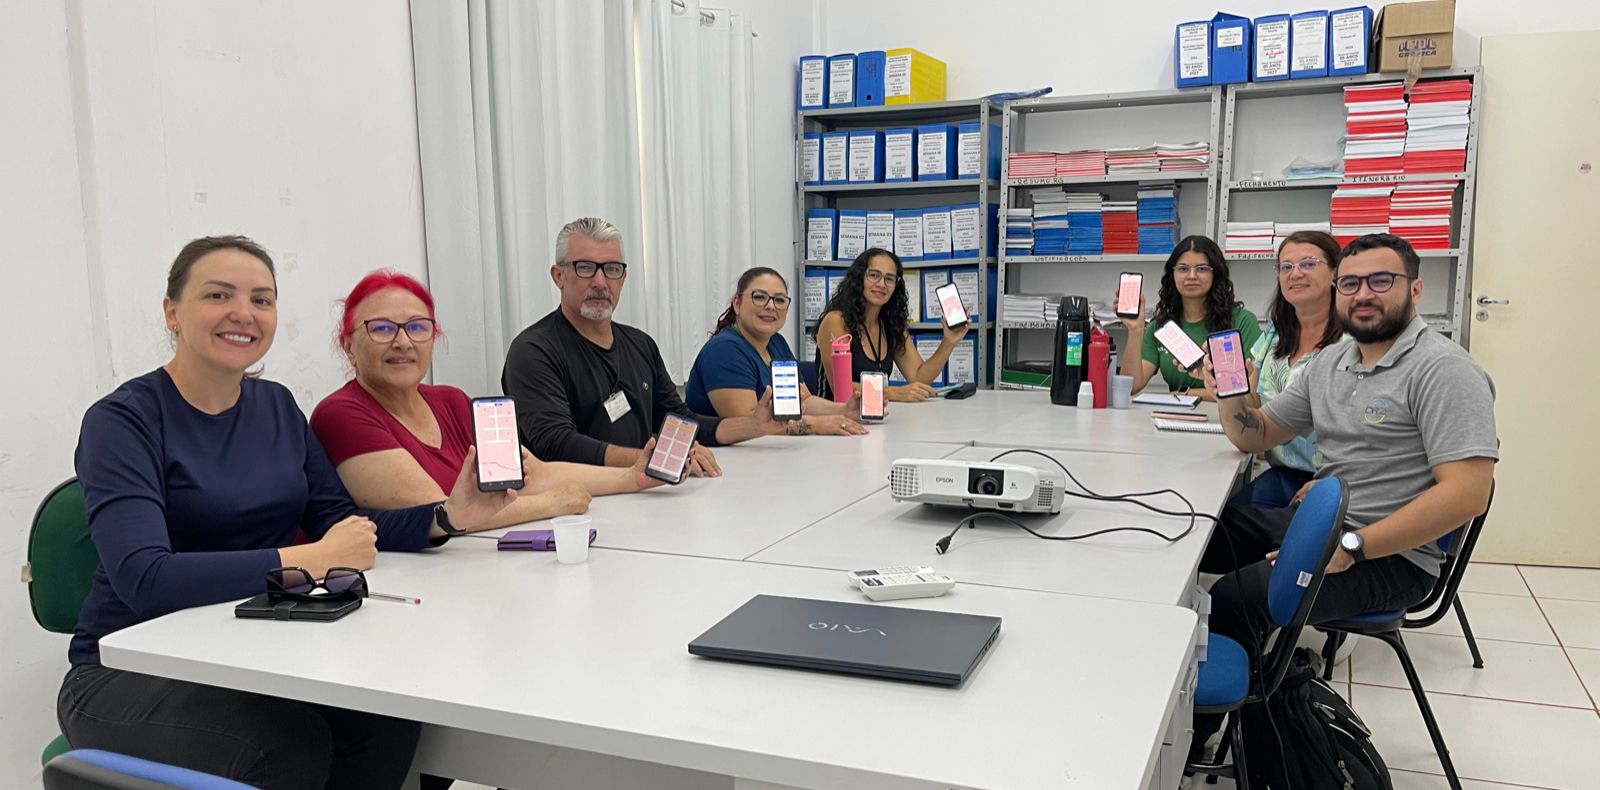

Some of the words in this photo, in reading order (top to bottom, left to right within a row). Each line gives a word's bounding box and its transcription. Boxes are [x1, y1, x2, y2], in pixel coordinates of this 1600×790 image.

[1398, 50, 1437, 58] GRICA
[1239, 180, 1286, 190] FECHAMENTO
[808, 622, 887, 636] VAIO
